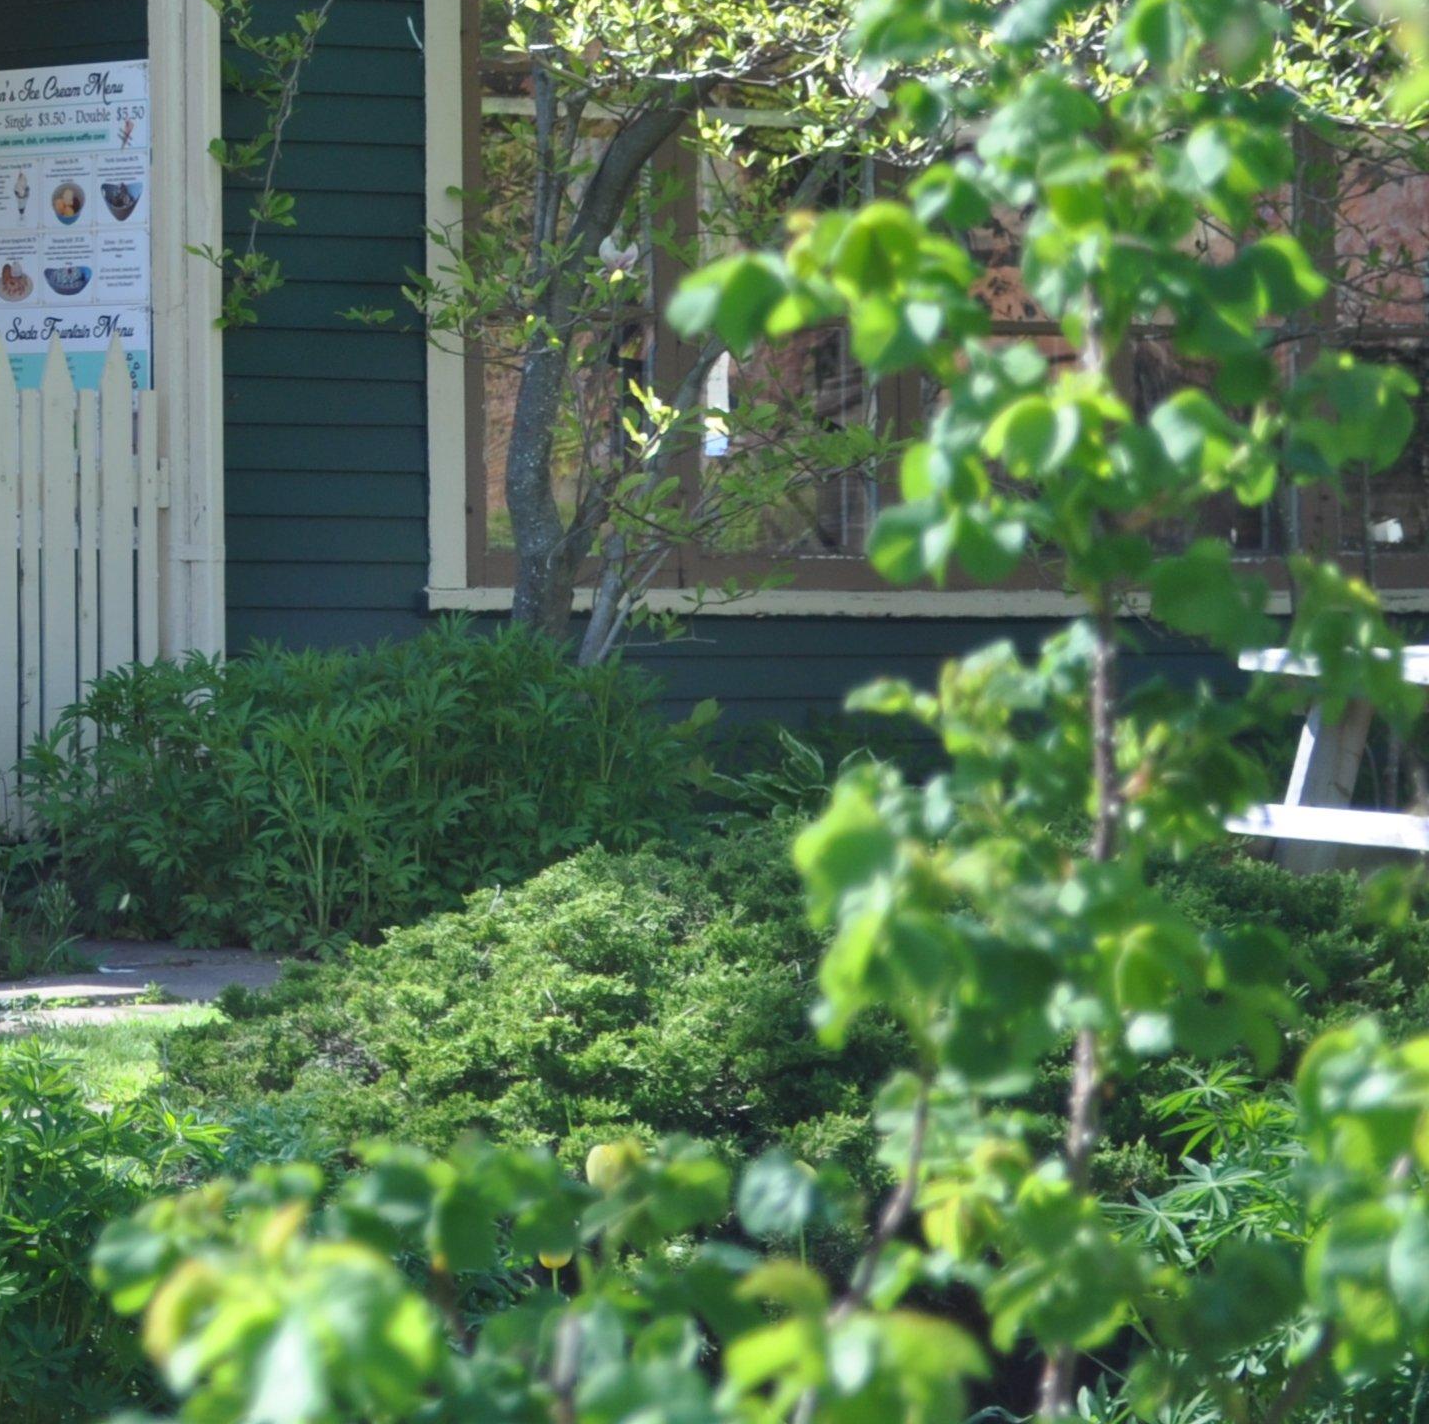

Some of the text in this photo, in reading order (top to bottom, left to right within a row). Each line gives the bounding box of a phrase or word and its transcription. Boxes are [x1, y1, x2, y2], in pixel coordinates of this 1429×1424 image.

[18, 77, 40, 102] Ice
[43, 76, 81, 100] Cream
[83, 70, 124, 106] Menu
[5, 113, 33, 132] Single
[38, 111, 66, 127] $3.50
[76, 107, 111, 124] Double
[117, 105, 145, 122] $5.50
[5, 317, 38, 342] Soda
[41, 317, 90, 340] Funtain
